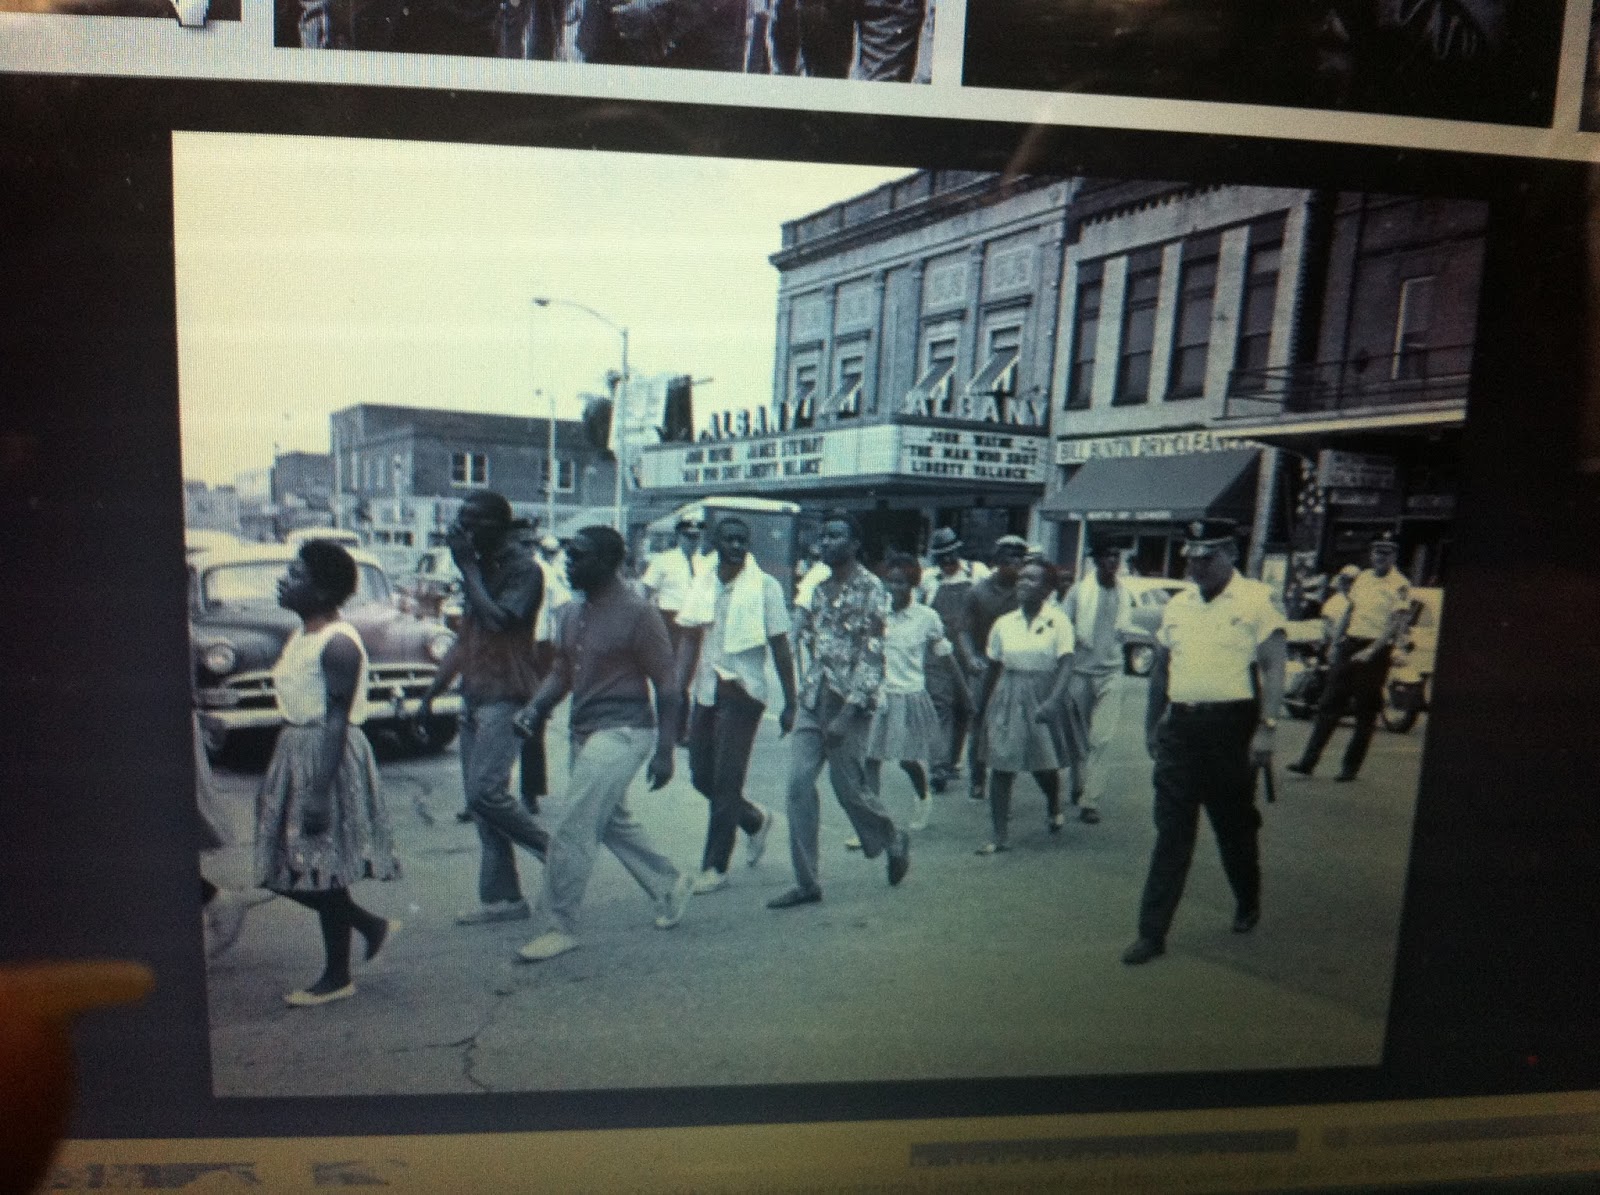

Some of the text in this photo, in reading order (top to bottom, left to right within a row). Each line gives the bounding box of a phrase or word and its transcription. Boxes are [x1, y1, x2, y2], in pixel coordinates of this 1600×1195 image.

[901, 391, 1047, 425] ALBANY
[699, 401, 801, 441] ALBANY
[929, 431, 960, 444] JOHN
[974, 435, 1014, 448] WAYNE
[943, 448, 970, 460] MAN
[976, 451, 1002, 462] WHO
[1007, 453, 1037, 465] SHOT
[912, 460, 964, 475] LIBERTY
